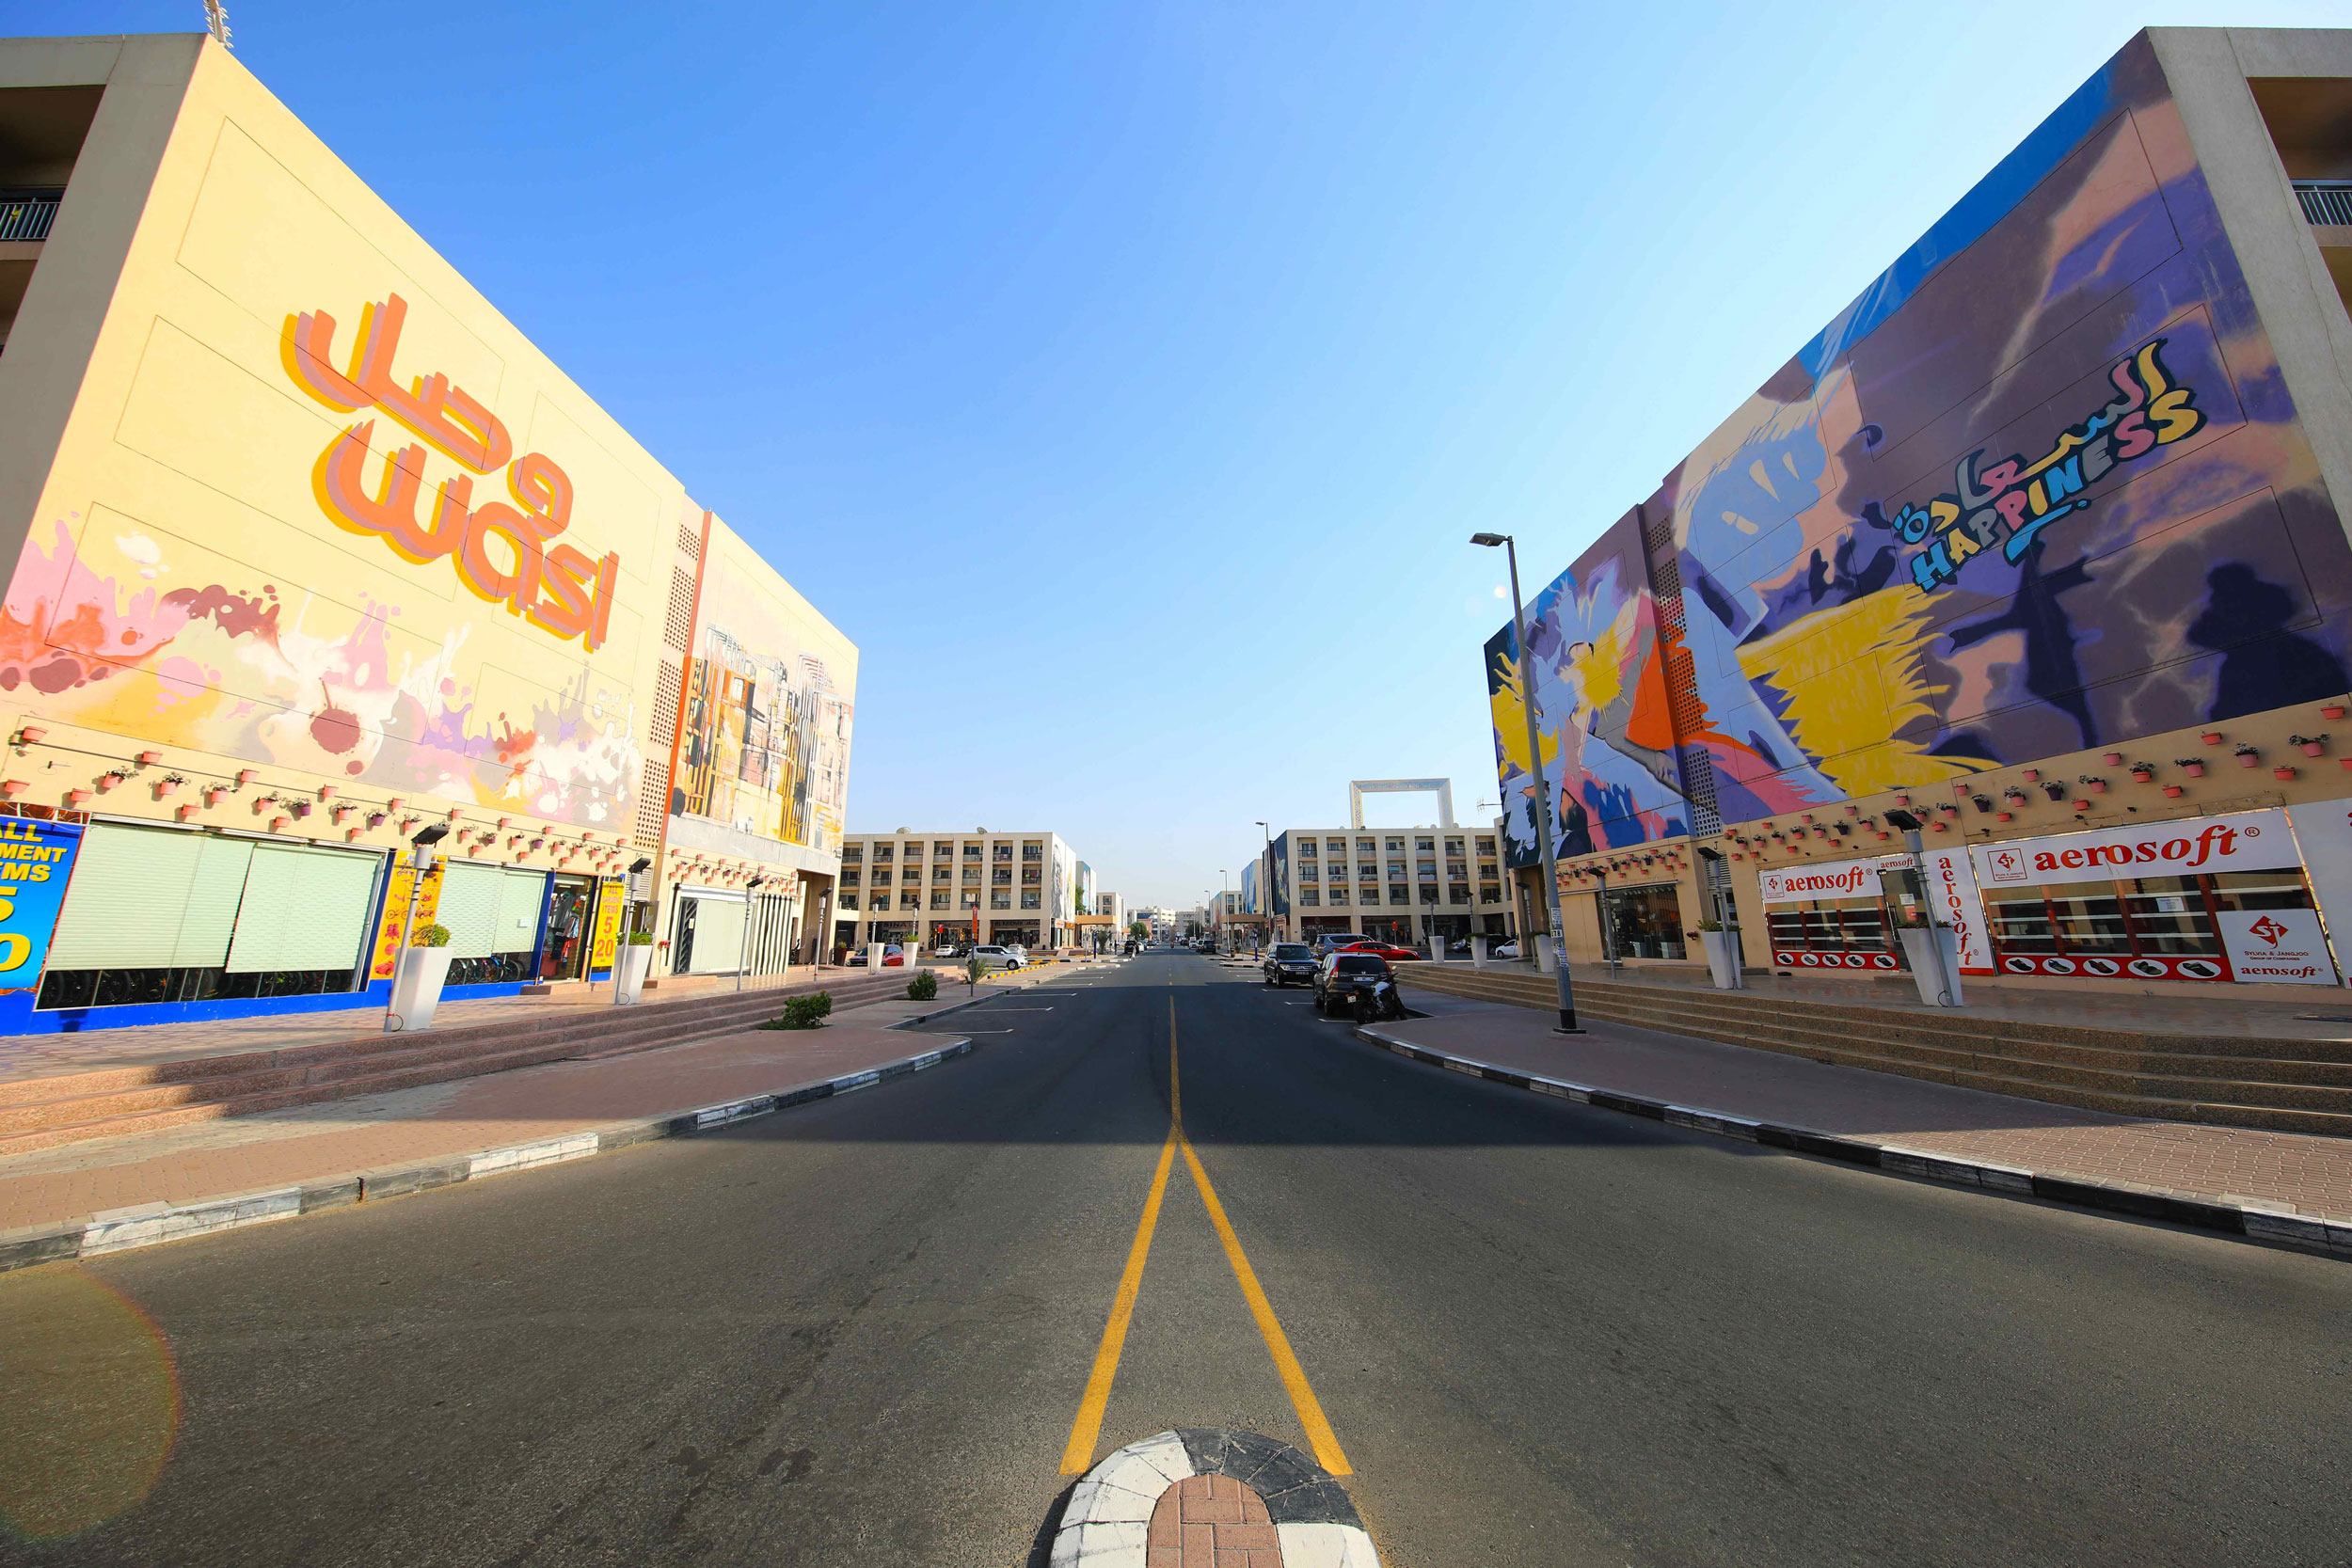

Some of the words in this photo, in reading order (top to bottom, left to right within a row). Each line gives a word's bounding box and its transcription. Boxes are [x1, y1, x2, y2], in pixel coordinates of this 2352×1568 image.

[280, 293, 574, 543] وصل
[1911, 388, 2208, 594] HAPPINESS
[0, 821, 43, 843] LL
[0, 861, 51, 882] MS
[1880, 857, 1914, 868] aerosoft
[603, 916, 613, 934] 5
[595, 939, 614, 958] 20
